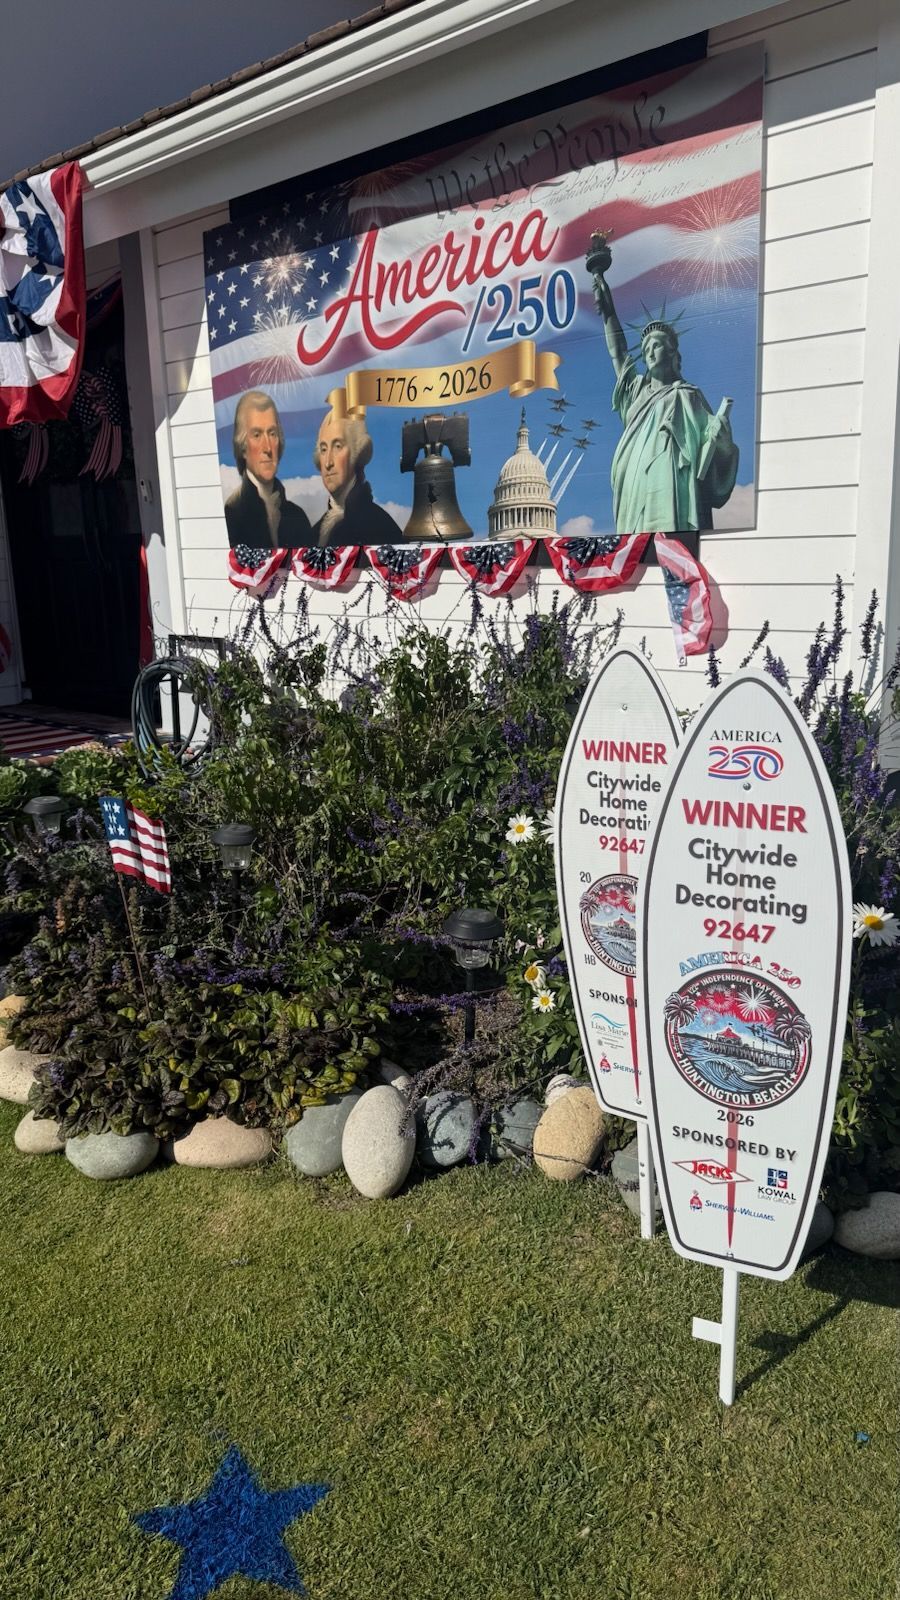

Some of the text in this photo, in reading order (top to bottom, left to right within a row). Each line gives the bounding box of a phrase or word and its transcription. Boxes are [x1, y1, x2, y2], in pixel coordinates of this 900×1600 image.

[532, 91, 667, 184] People
[297, 209, 560, 366] America
[709, 730, 783, 743] AMERICA
[582, 739, 668, 765] WINNER
[708, 745, 785, 782] 250
[587, 770, 661, 794] Citywide
[600, 791, 647, 811] Home
[580, 808, 651, 831] Decorati
[681, 798, 809, 834] WINNER
[599, 835, 646, 854] 92647
[688, 837, 798, 868] Citywide
[706, 863, 777, 890] Home
[675, 883, 808, 925] Decorating
[703, 918, 776, 944] 92647
[679, 950, 802, 989] AMERICA 250
[679, 1058, 795, 1105] HUNTINGTON BEACH
[717, 1110, 754, 1127] 2026
[672, 1126, 797, 1161] SPONSORED BY
[691, 1160, 734, 1180] JACKS
[757, 1186, 797, 1201] KOWAL
